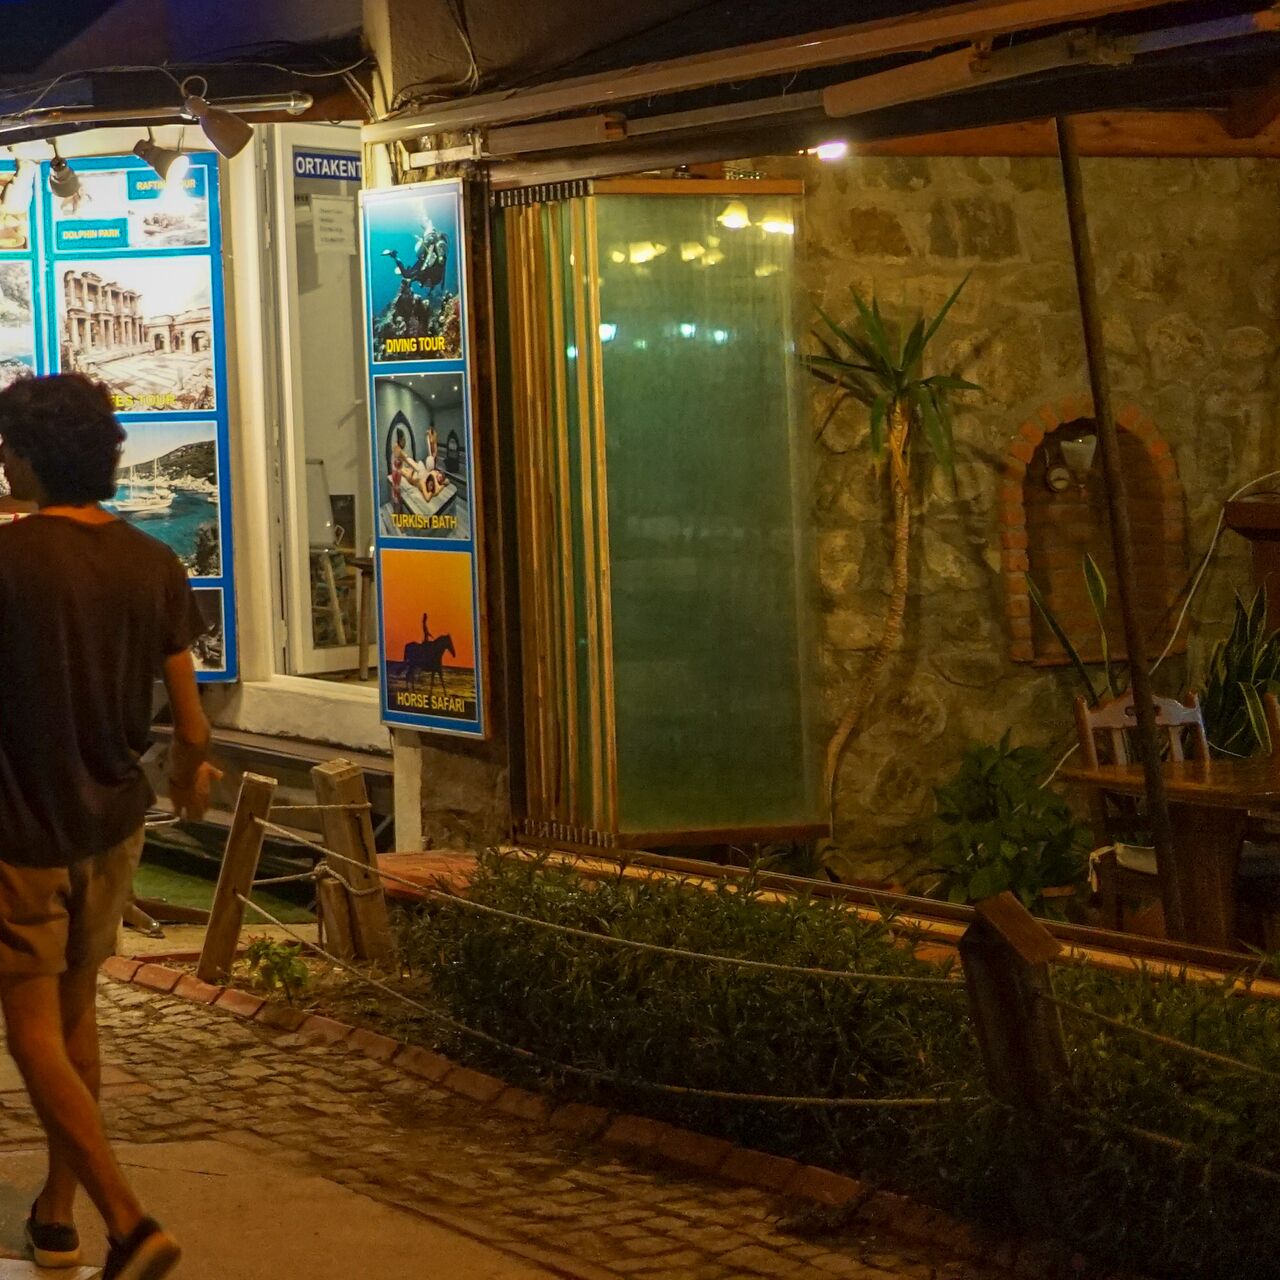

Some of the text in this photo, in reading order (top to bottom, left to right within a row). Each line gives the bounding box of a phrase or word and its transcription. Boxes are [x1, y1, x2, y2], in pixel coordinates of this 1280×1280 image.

[295, 156, 362, 178] ORTAKENT
[386, 336, 446, 353] DIVING TOUR
[391, 513, 458, 530] TURKISH BATH
[396, 692, 465, 713] HORSE SAFARI
